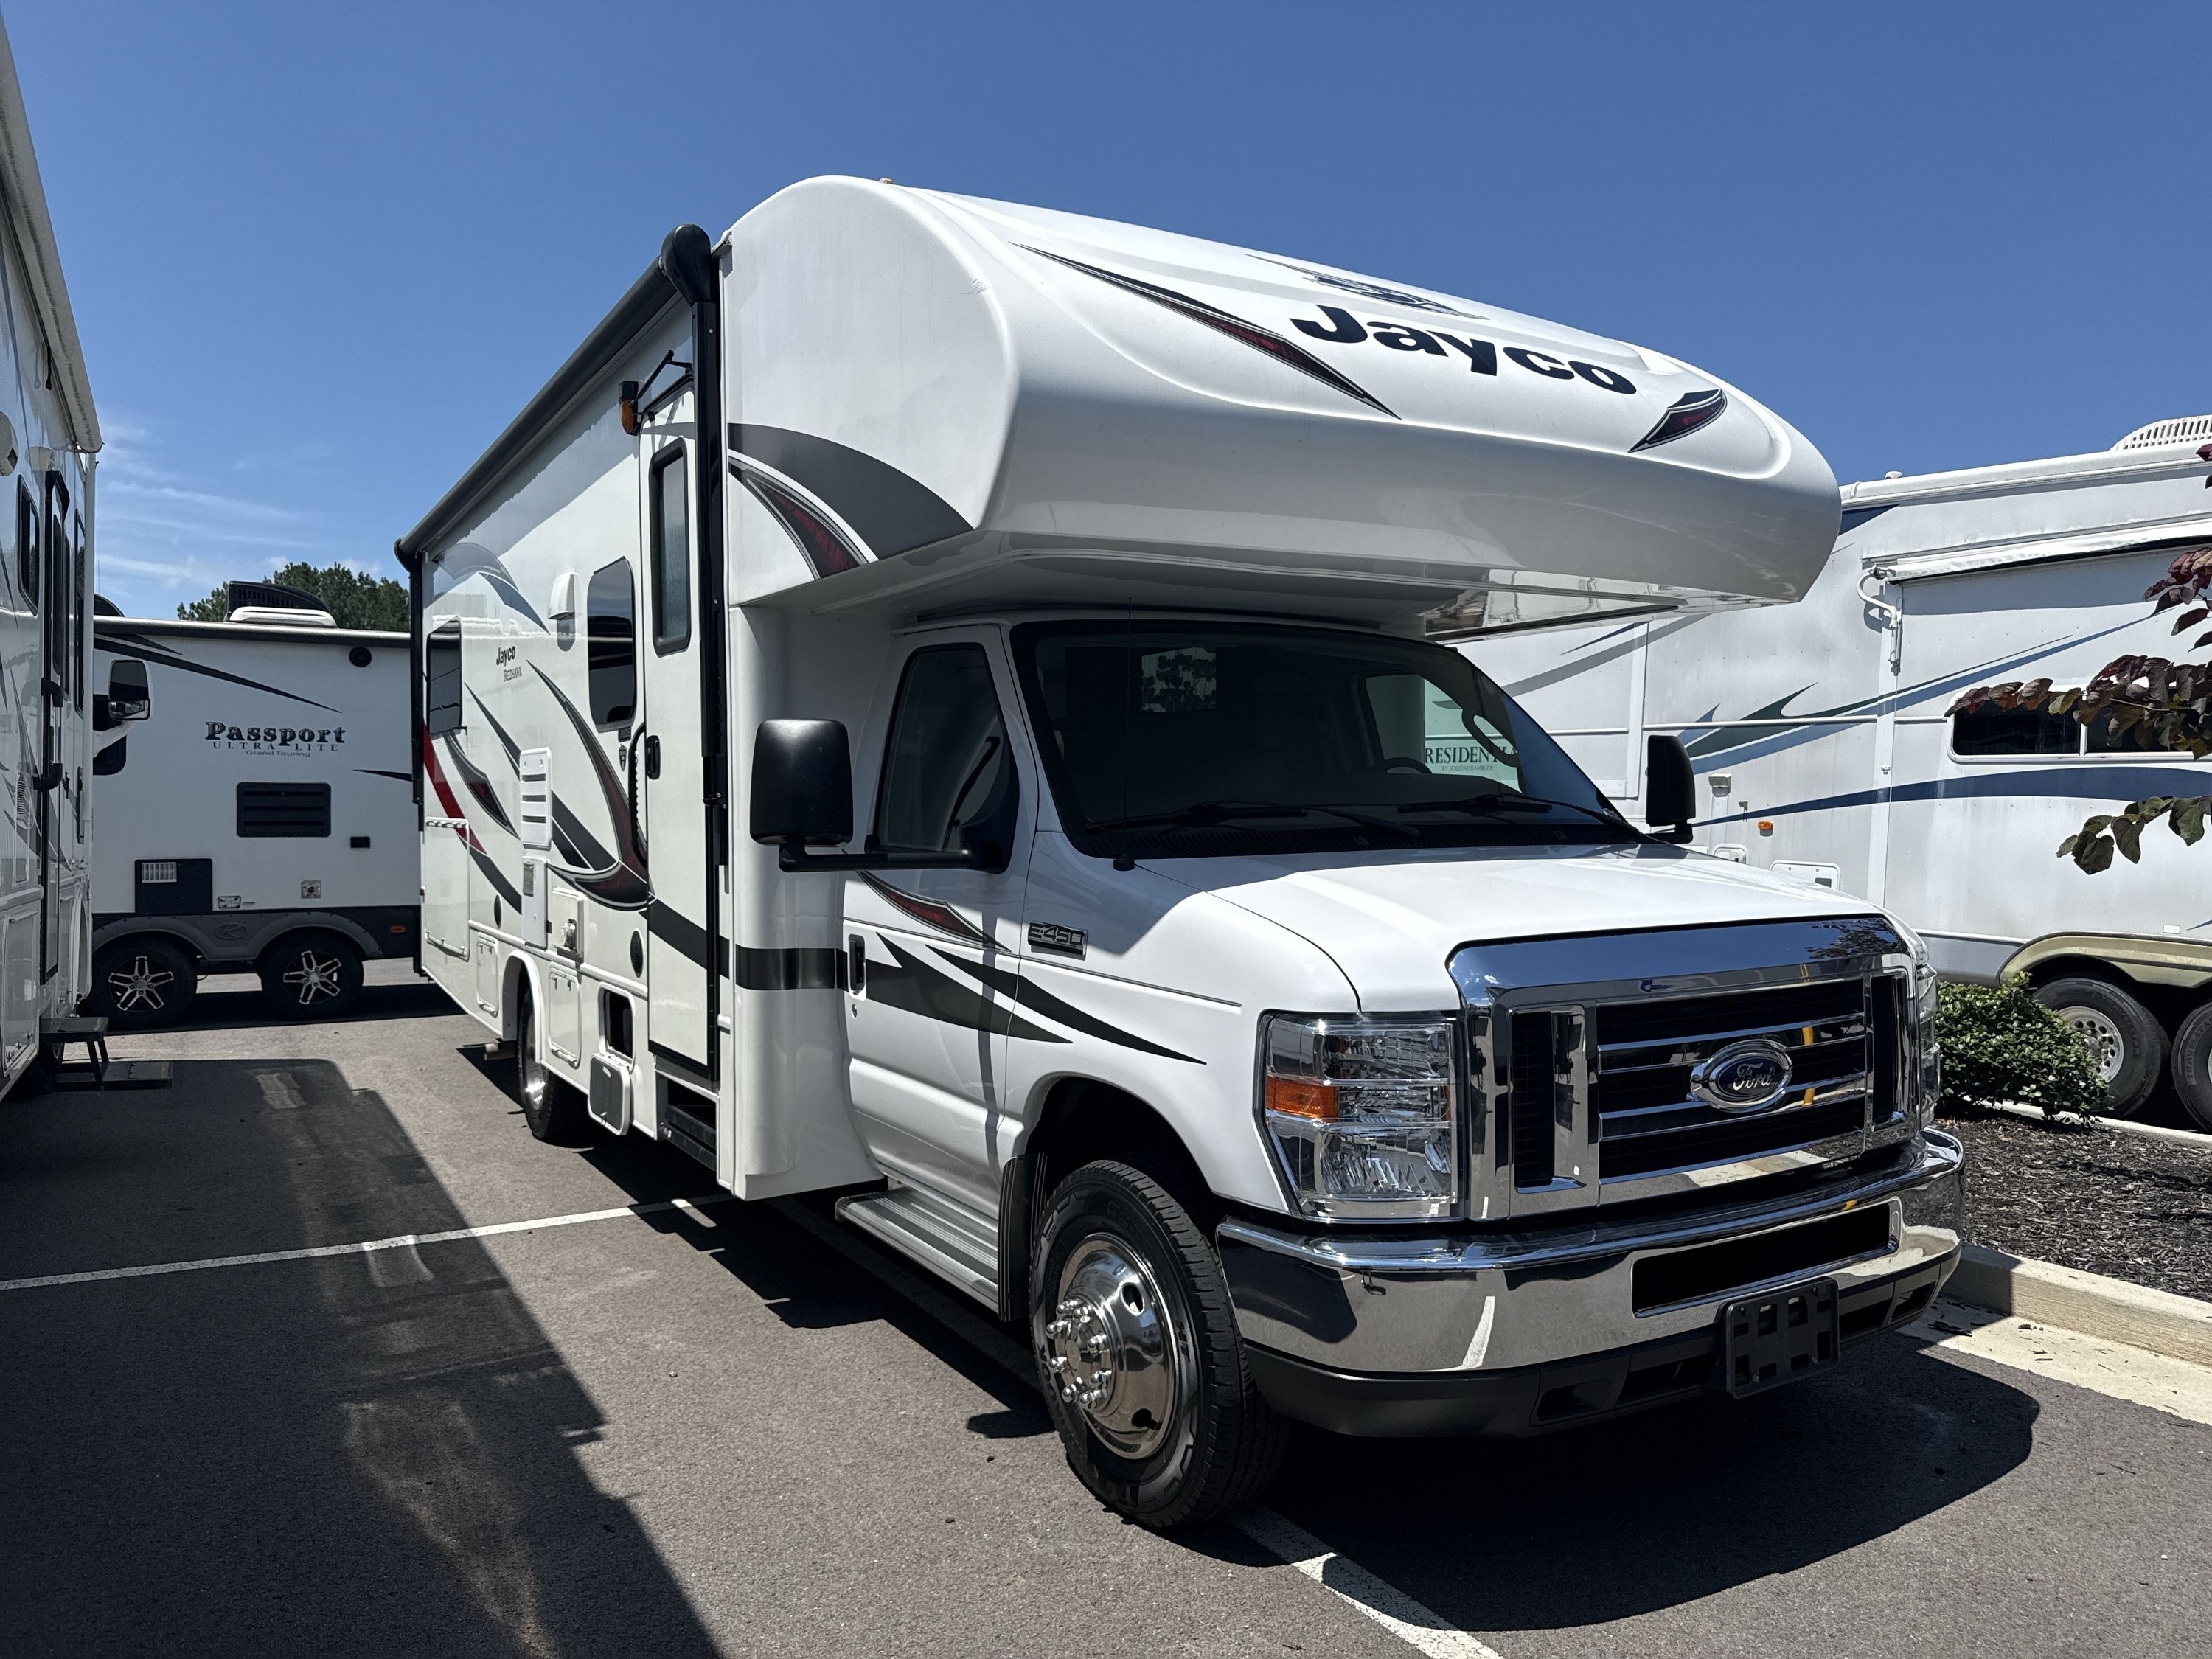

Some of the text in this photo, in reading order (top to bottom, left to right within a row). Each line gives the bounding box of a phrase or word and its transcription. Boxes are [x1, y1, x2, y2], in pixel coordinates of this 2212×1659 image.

[1289, 304, 1637, 394] Jayco
[496, 646, 515, 667] Jayco
[205, 721, 346, 746] Passport
[213, 742, 338, 751] ULTRA LITE
[2185, 1016, 2212, 1078] TRAVELSTA
[1733, 1062, 1775, 1091] Ford
